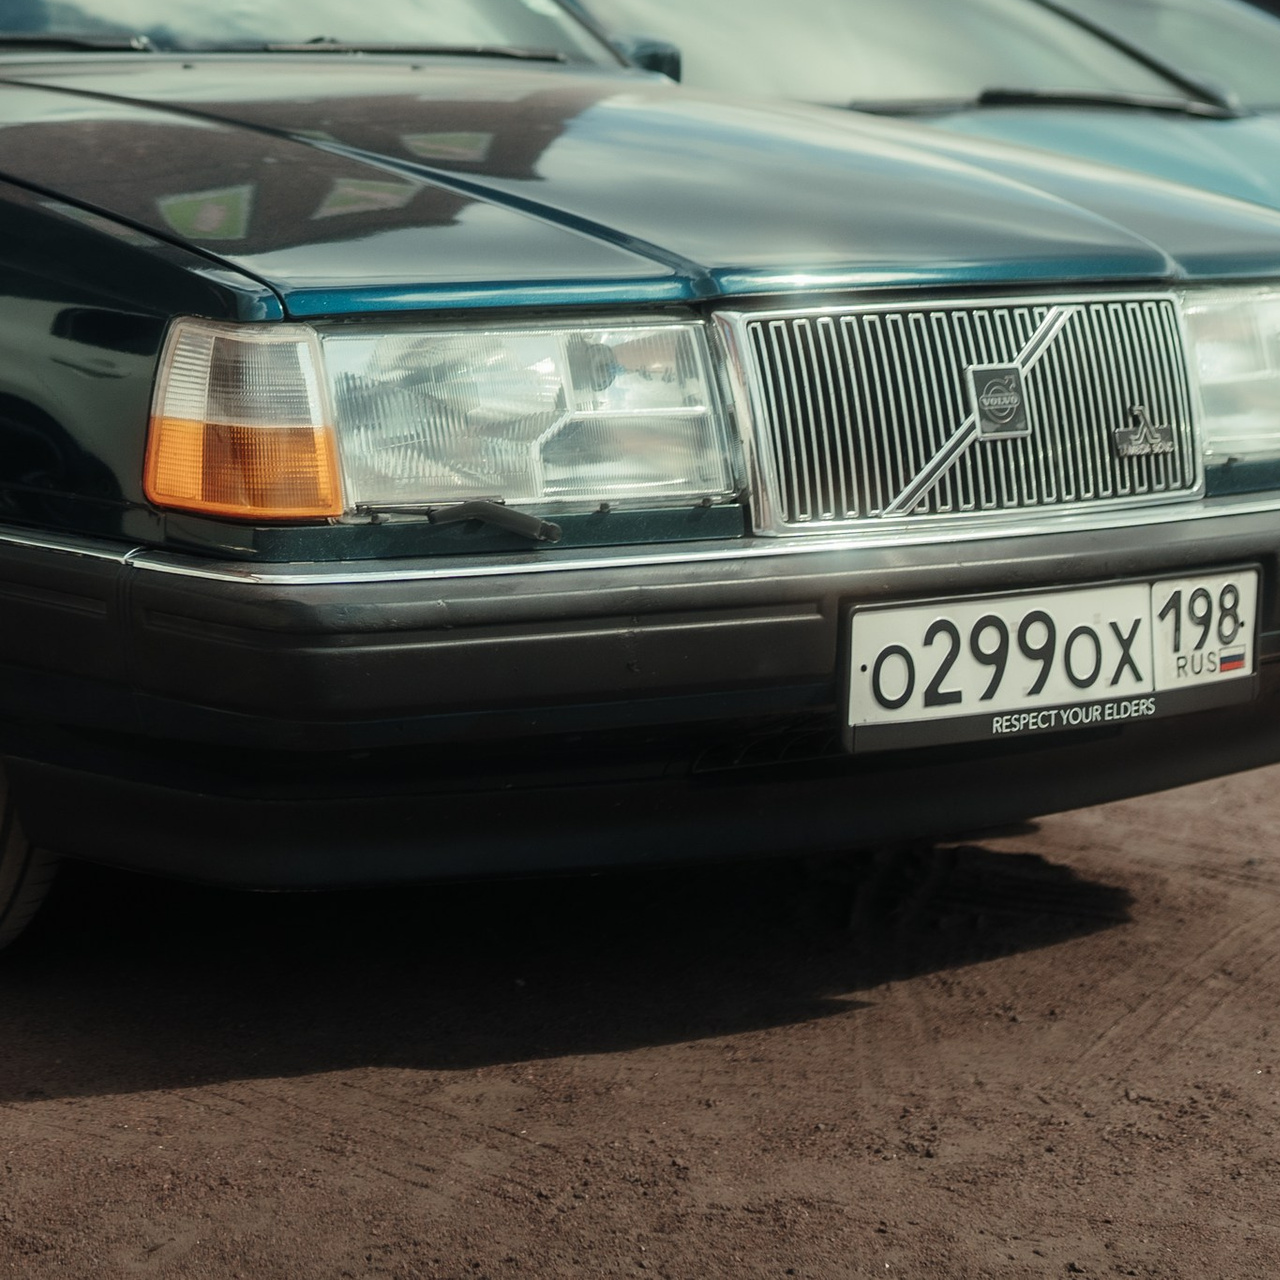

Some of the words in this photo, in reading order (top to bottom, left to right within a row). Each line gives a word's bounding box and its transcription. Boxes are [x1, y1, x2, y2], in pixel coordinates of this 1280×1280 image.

[981, 394, 1018, 407] VOLVO
[1158, 583, 1239, 653] 198
[1176, 651, 1218, 678] RUS
[992, 709, 1059, 734] RESPECT
[1059, 704, 1102, 726] YOUR
[1104, 697, 1157, 721] ELDERS
